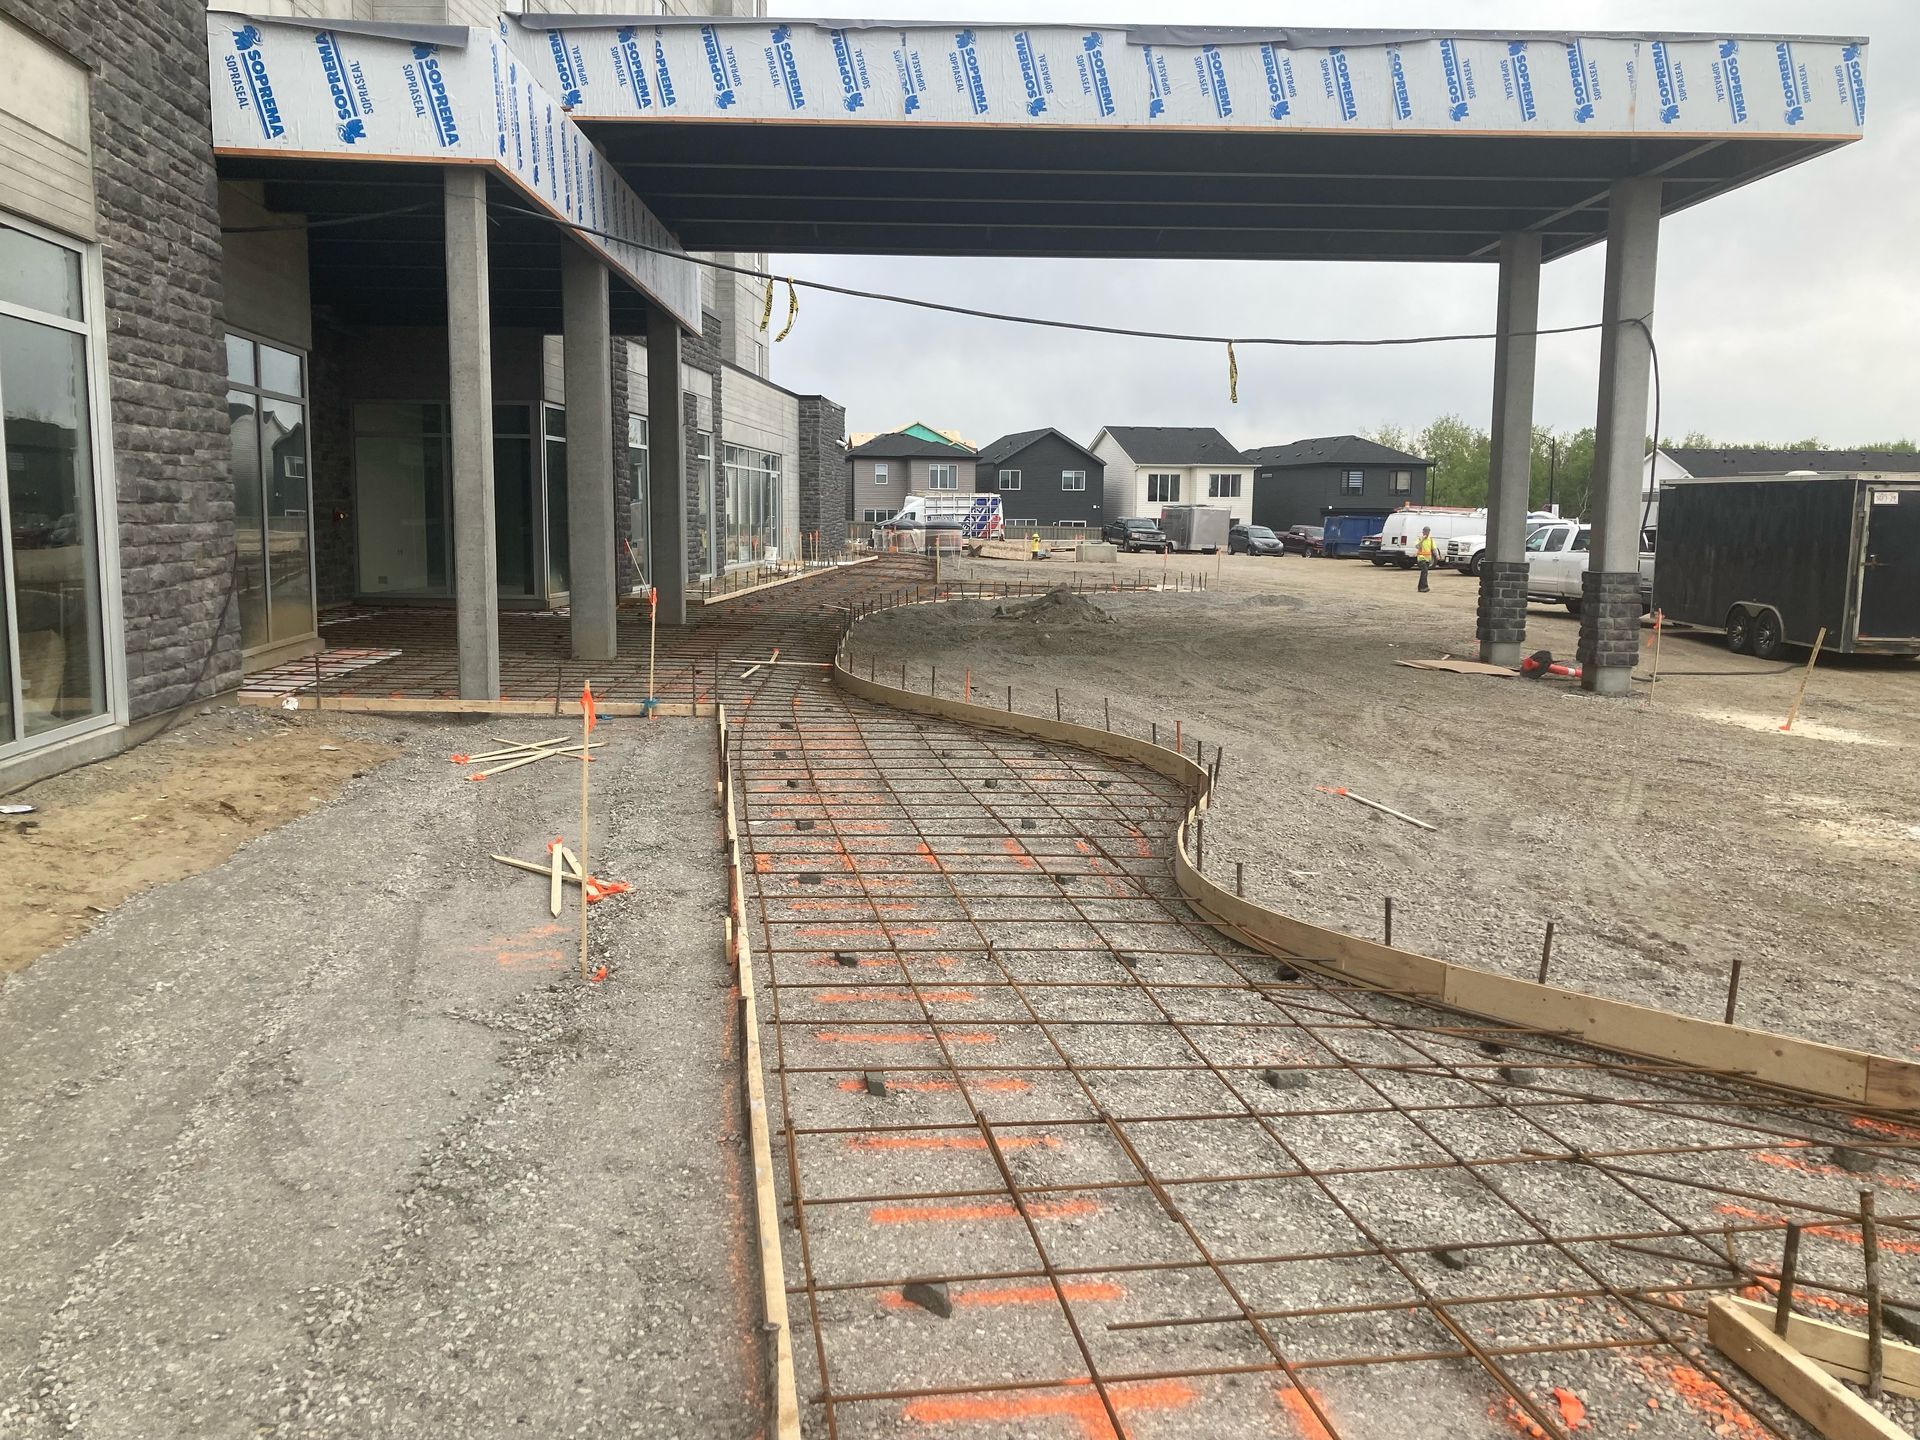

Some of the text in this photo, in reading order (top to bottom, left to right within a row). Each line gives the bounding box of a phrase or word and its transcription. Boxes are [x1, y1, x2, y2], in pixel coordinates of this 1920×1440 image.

[225, 55, 248, 110] SOPRASEAL
[315, 31, 351, 120] SOPREMA
[571, 45, 589, 87] SOPRASEAL
[611, 47, 627, 87] SOPRASEAL
[626, 42, 652, 109] SOPREMA
[701, 24, 726, 91] SOPREMA
[726, 46, 742, 87] SOPRASEAL
[764, 47, 781, 88] SOPRASEAL
[780, 42, 806, 110] SOPREMA
[855, 48, 871, 89] SOPRASEAL
[949, 52, 964, 93] SOPRASEAL
[965, 47, 988, 115] SOPREMA
[1014, 31, 1038, 99] SOPREMA
[1039, 53, 1054, 95] SOPRASEAL
[1076, 54, 1092, 95] SOPRASEAL
[1092, 50, 1115, 117] SOPREMA
[1156, 54, 1172, 96] SOPRASEAL
[1194, 56, 1210, 97] SOPRASEAL
[1260, 42, 1281, 102] SOPREM
[1282, 57, 1297, 98] SOPRASEAL
[1320, 58, 1335, 99] SOPRASEAL
[1462, 59, 1476, 99] SOPRASEAL
[1500, 59, 1514, 100] SOPRASEAL
[1588, 60, 1601, 101] SOPRASEAL
[1651, 42, 1671, 106] SOPREMA
[1674, 60, 1688, 102] SOPRASEAL
[1711, 62, 1725, 103] SOPRASEAL
[1776, 42, 1797, 108] SOPREMA
[1834, 64, 1847, 105] SOPRASEAL
[248, 49, 285, 139] SOPREMA
[350, 60, 373, 114] SOPRASEAL
[403, 64, 426, 118] SOPRASEAL
[426, 59, 461, 146] SOPREMA
[1211, 51, 1233, 119] SOPREMA
[1336, 54, 1358, 121] SOPREMA
[1515, 54, 1537, 121] SOPREMA
[1727, 57, 1747, 124] SOPREMA
